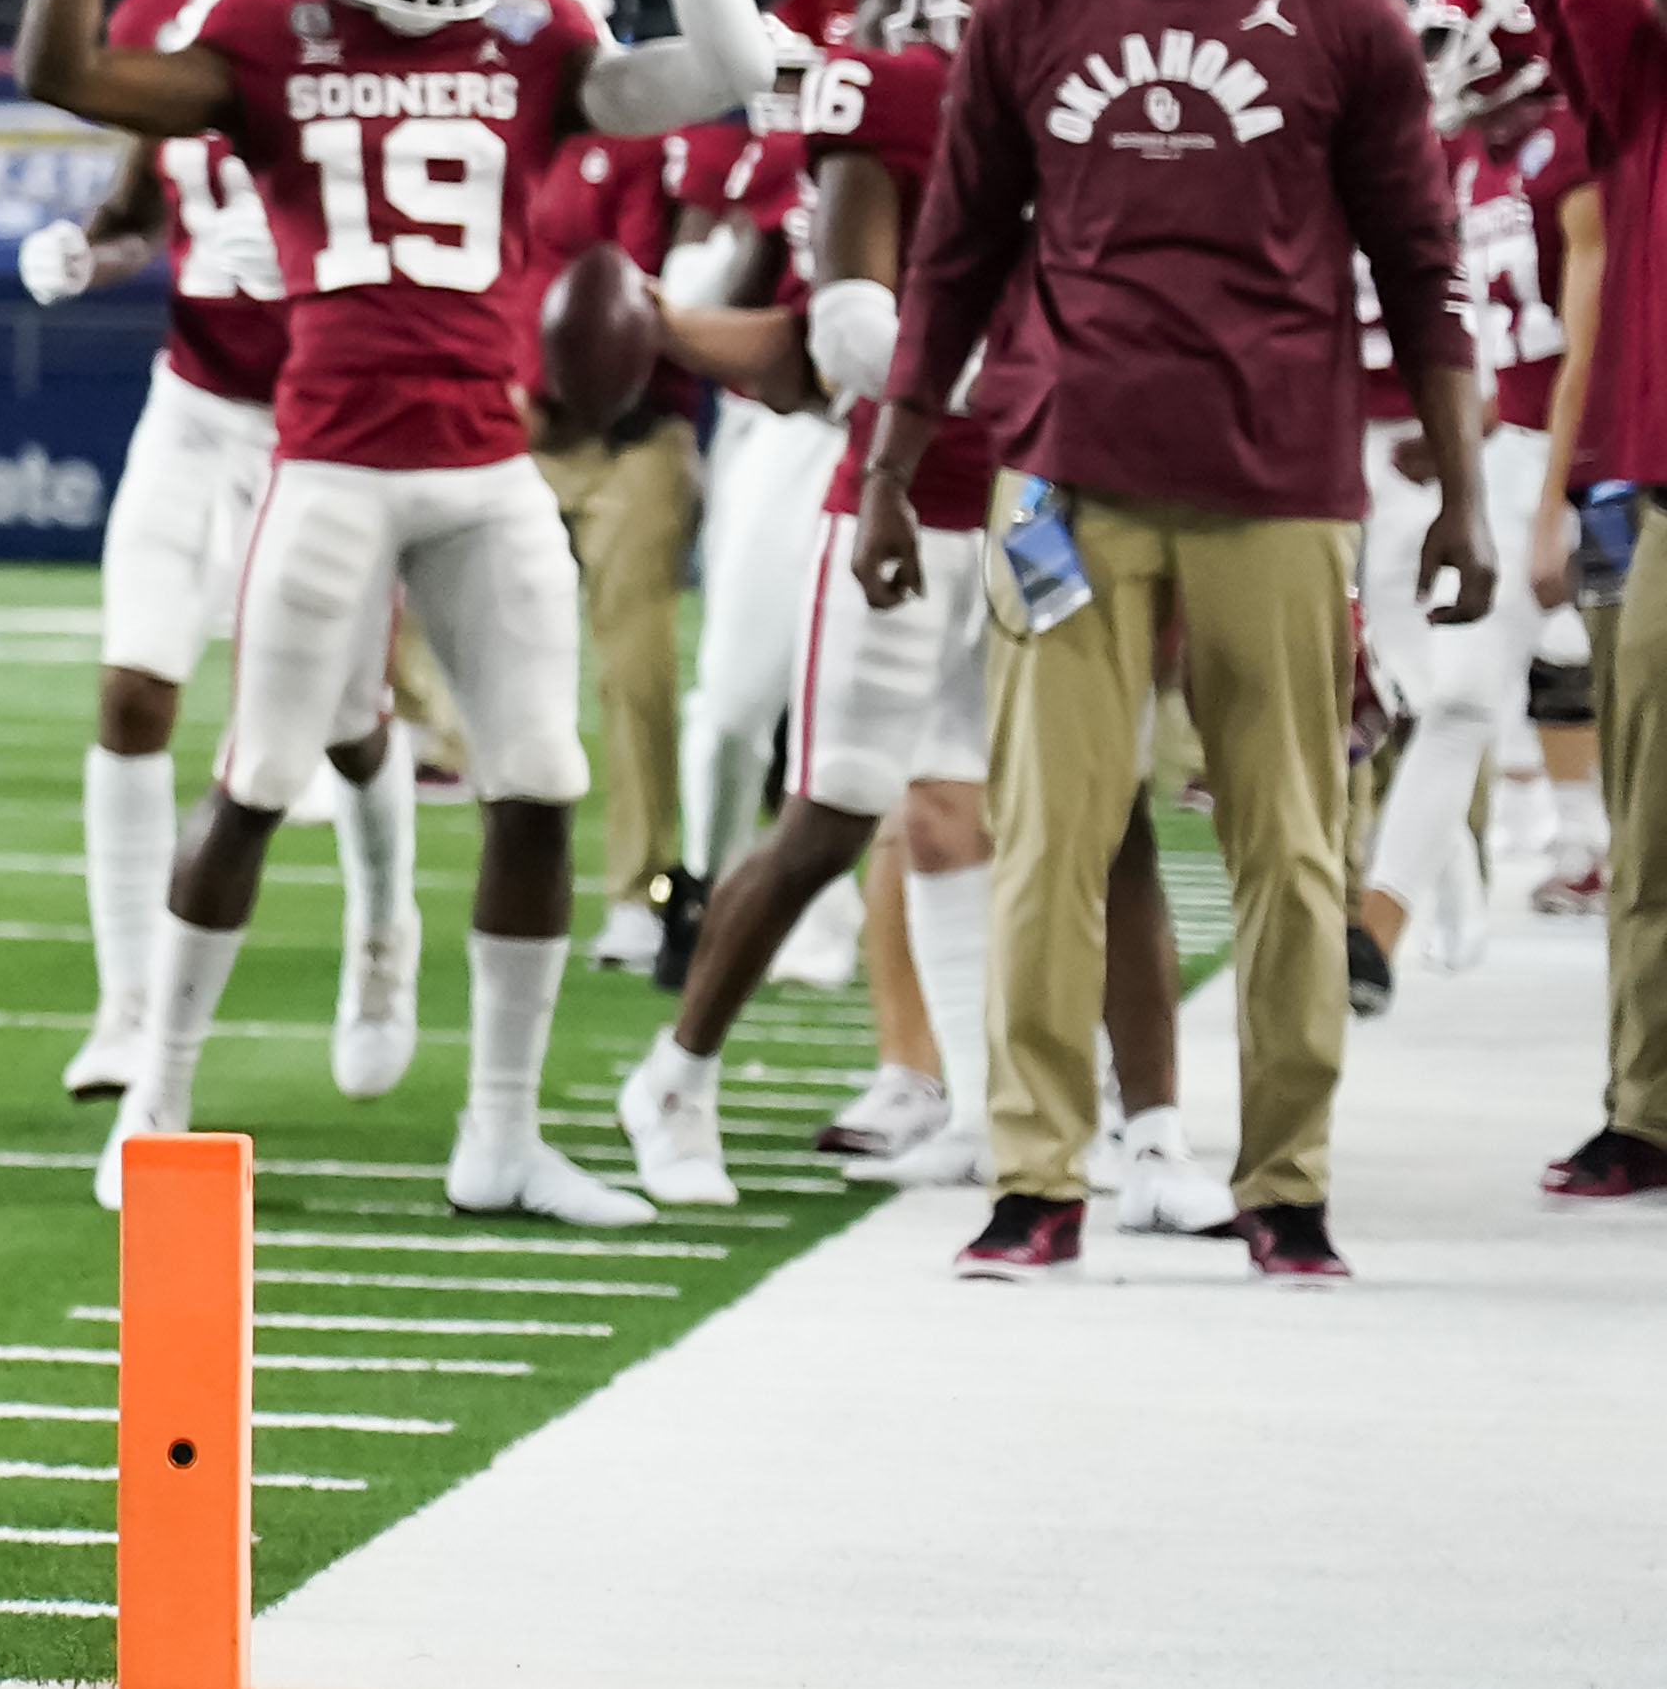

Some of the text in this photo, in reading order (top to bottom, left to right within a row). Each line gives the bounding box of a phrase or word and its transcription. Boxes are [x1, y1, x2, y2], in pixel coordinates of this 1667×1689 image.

[285, 72, 519, 120] SOONERS
[1045, 27, 1284, 144] OKLAHOMA
[301, 117, 507, 293] 19
